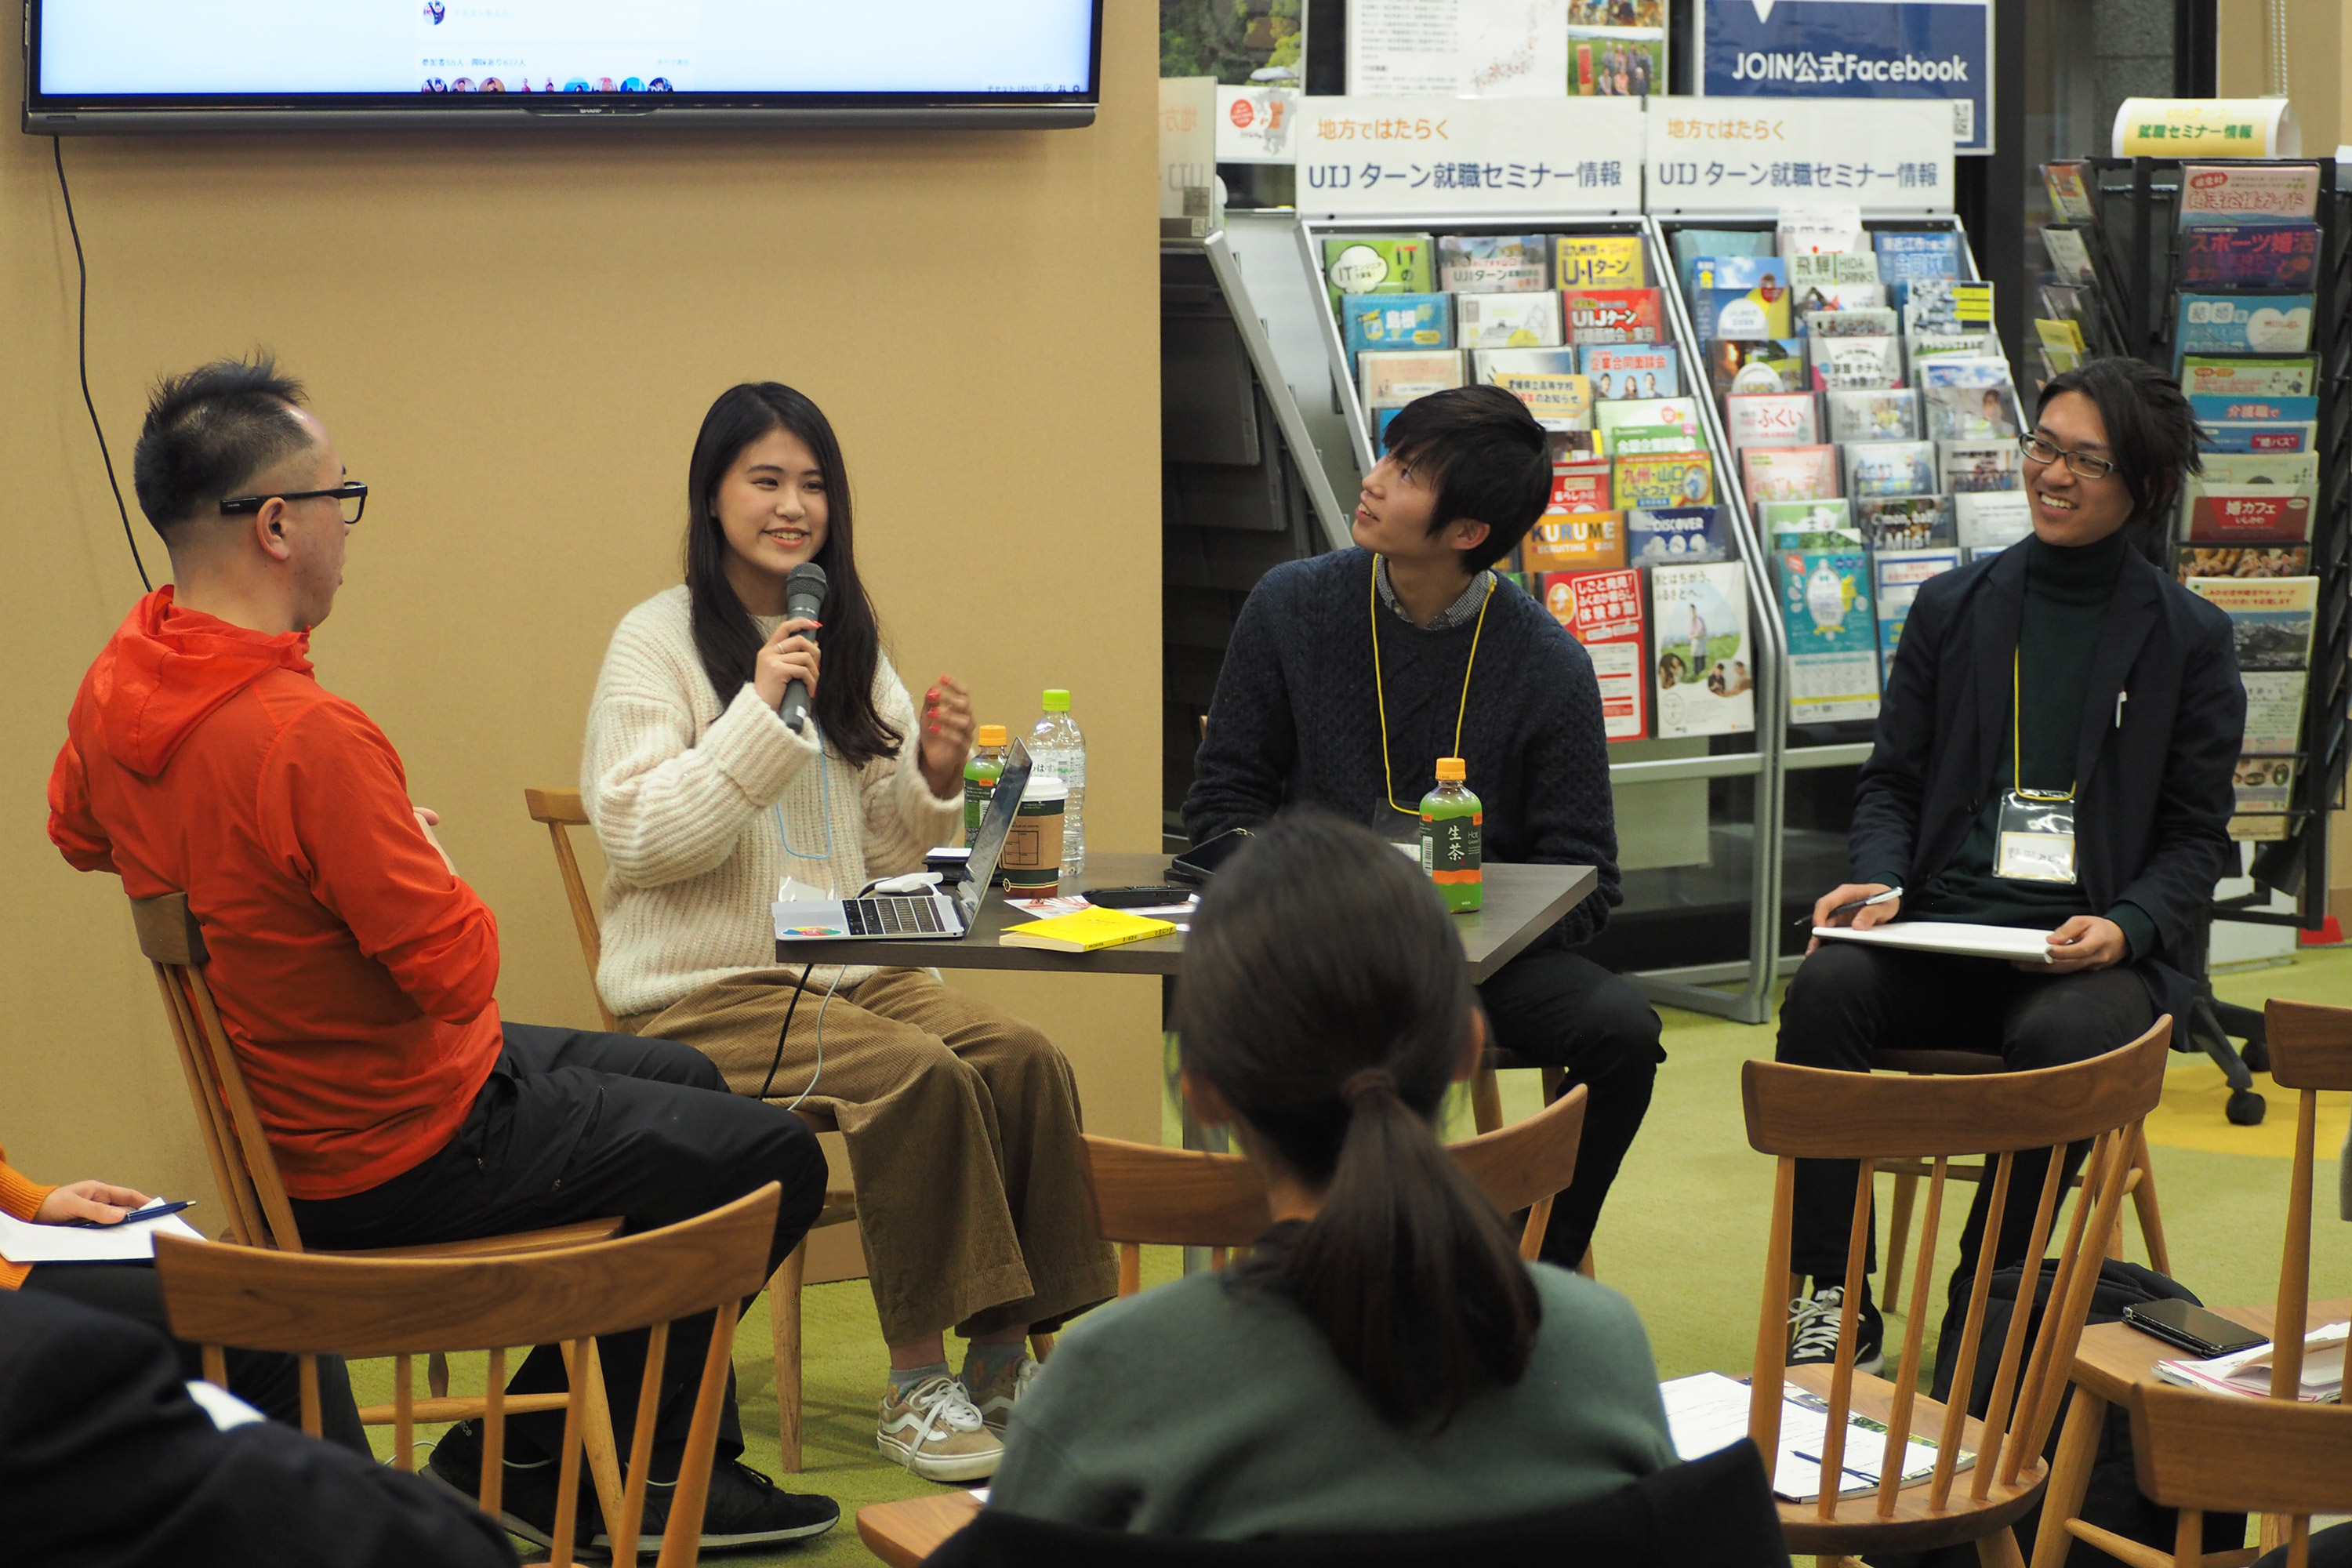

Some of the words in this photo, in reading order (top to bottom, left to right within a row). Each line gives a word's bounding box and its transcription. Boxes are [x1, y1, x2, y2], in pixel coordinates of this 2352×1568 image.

[1731, 51, 1969, 84] JOIN公式Facebook
[1317, 118, 1449, 140] 地方ではたらく
[1667, 119, 1785, 140] 地方ではたらく
[2137, 123, 2253, 140] 就職セミナー情報
[1839, 257, 1865, 270] HIDA
[1338, 267, 1352, 281] IT
[1839, 270, 1875, 284] DRINKS
[1758, 408, 1806, 428] ふくい
[1531, 521, 1616, 543] KURUME
[1652, 517, 1704, 532] DISCOVER
[1447, 825, 1465, 862] 生茶
